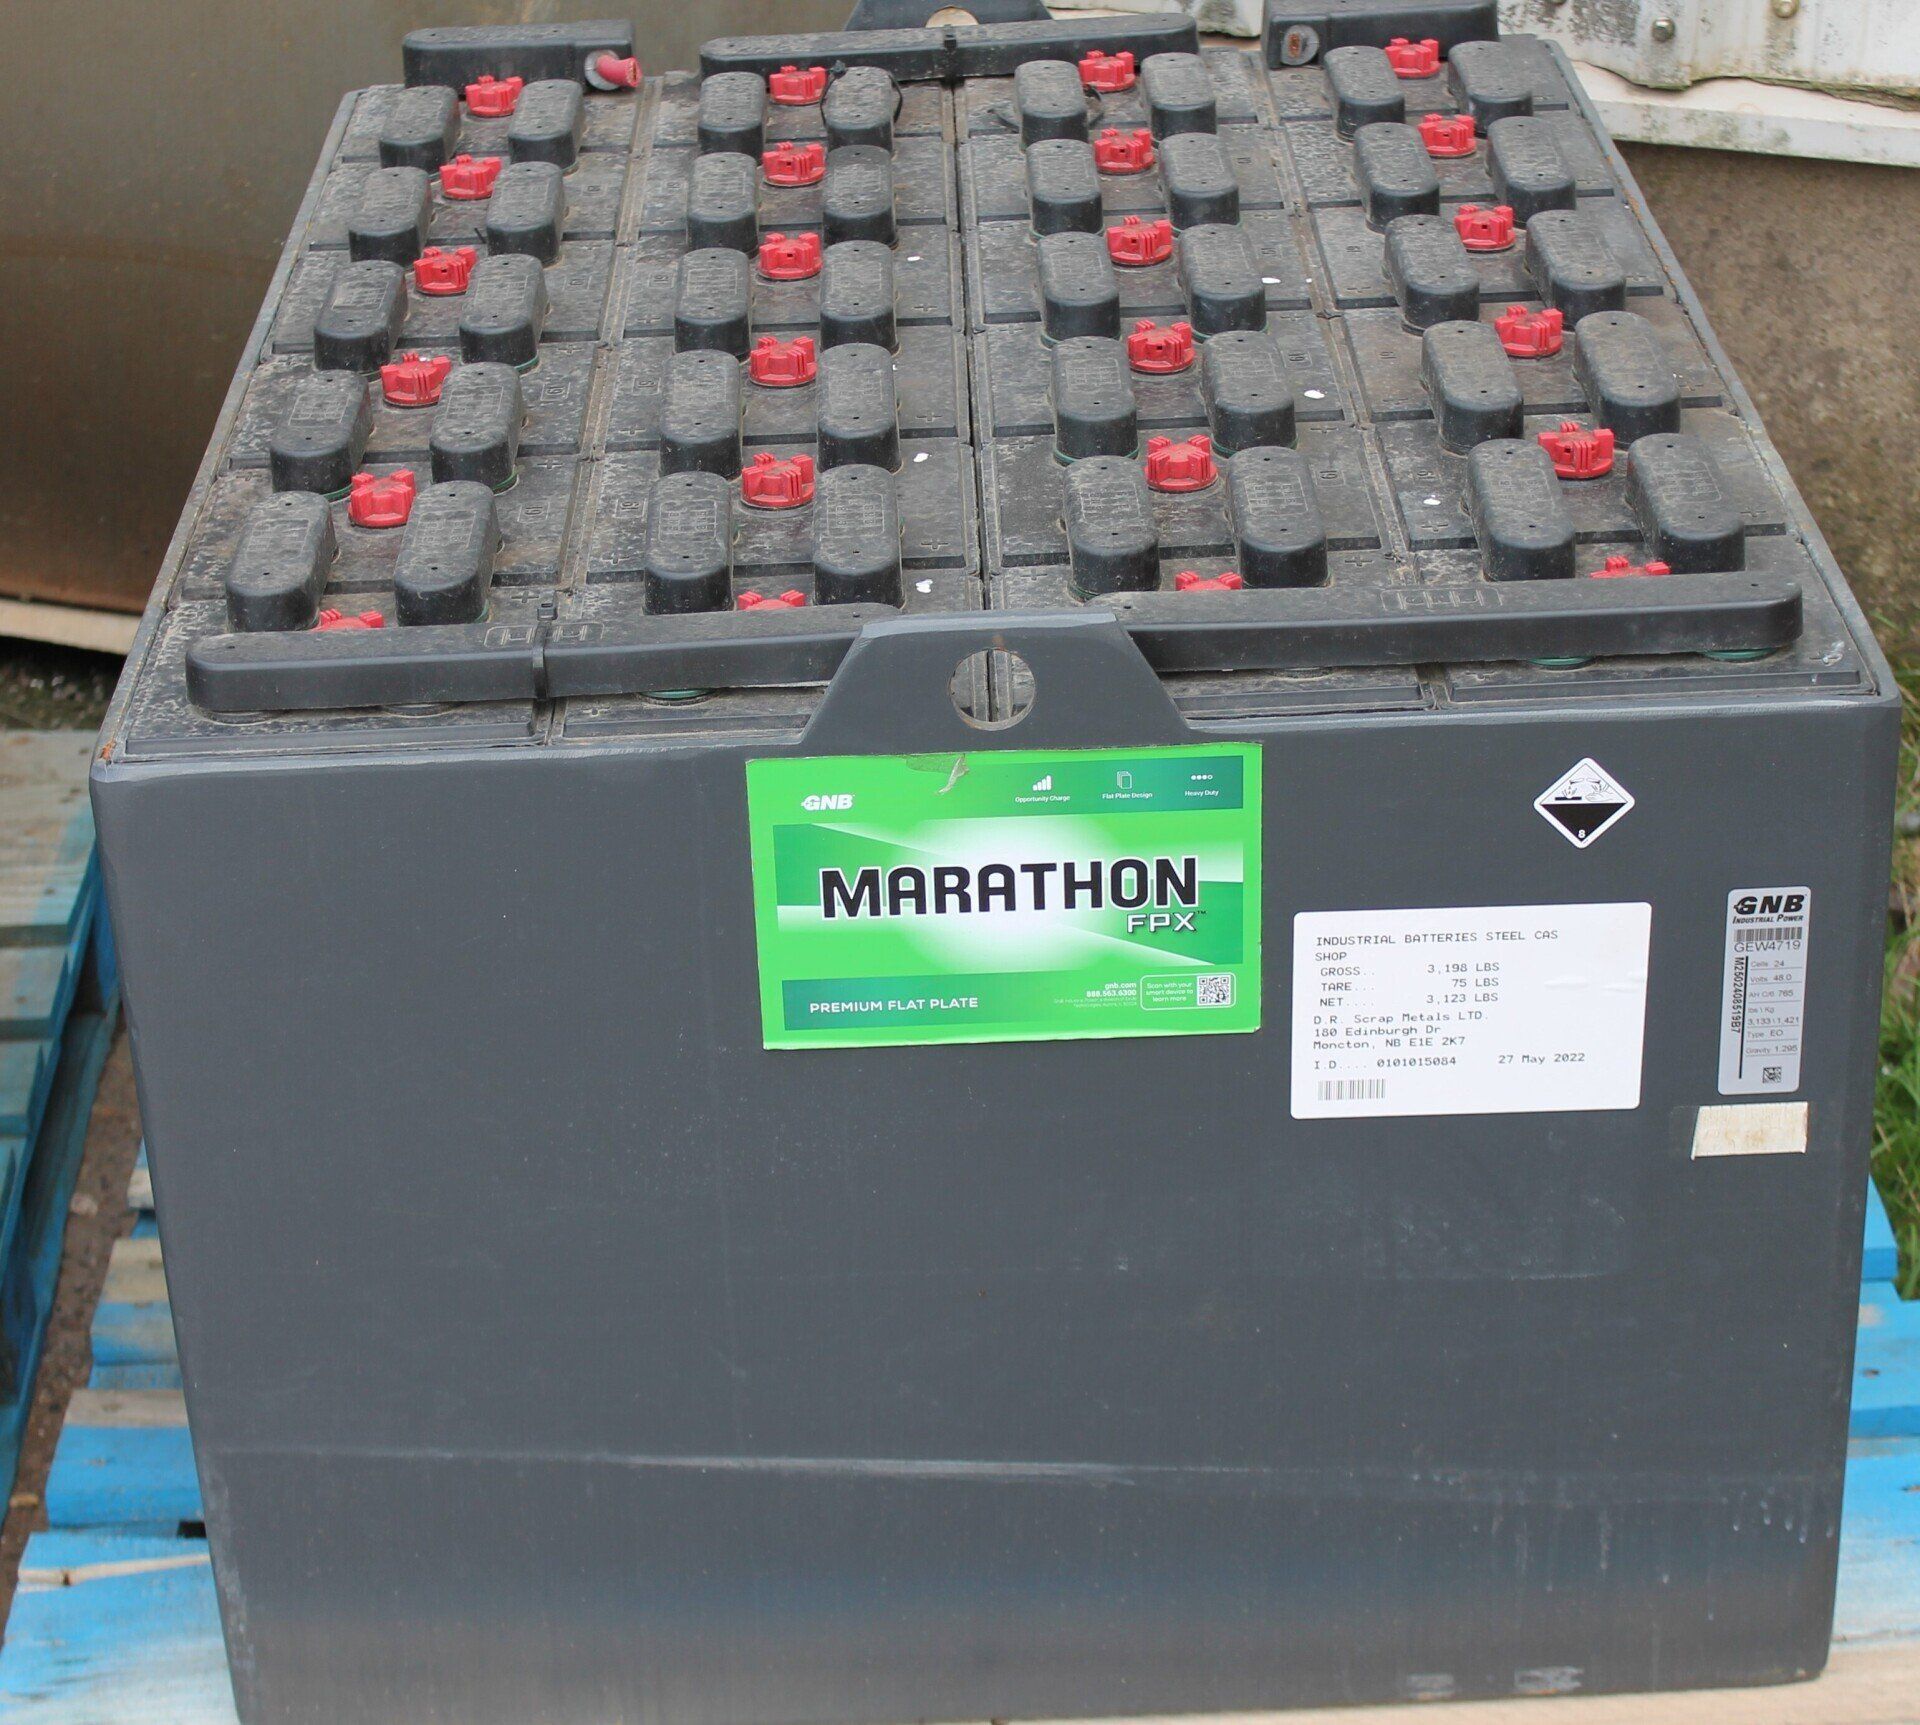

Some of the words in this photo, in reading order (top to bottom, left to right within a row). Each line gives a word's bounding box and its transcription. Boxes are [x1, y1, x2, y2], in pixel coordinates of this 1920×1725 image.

[1132, 791, 1153, 799] Design
[1204, 789, 1219, 797] Duty
[801, 794, 852, 810] GNB
[1578, 830, 1586, 838] 8
[819, 855, 1199, 920] MARATHON
[1734, 895, 1804, 914] GNB
[1316, 935, 1395, 946] INDUSTRIAL
[1405, 932, 1477, 943] BATTERIES
[1486, 930, 1525, 941] STEEL
[1535, 929, 1558, 940] CAS
[1734, 940, 1800, 952] GEW4719
[1315, 951, 1347, 961] SHOP
[1427, 963, 1468, 974] 3,198
[1476, 962, 1500, 972] LBS
[1105, 982, 1136, 990] gnb.com
[1452, 978, 1468, 988] 75
[1475, 977, 1499, 987] LBS
[1427, 992, 1467, 1004] 3,123
[1474, 992, 1498, 1002] LBS
[810, 1001, 883, 1013] PREMIUM
[887, 999, 925, 1011] FLAT
[929, 997, 979, 1009] PLATE
[1314, 1015, 1343, 1025] D.R.
[1354, 1013, 1393, 1024] Scrap
[1403, 1011, 1449, 1022] Metals
[1315, 1027, 1337, 1037] 180
[1346, 1025, 1417, 1036] Edinburgh
[1426, 1025, 1441, 1035] Dr
[1313, 1041, 1376, 1050] Moncton,
[1386, 1038, 1401, 1048] NB
[1410, 1037, 1433, 1047] E1E
[1442, 1036, 1465, 1046] 2K7
[1377, 1057, 1457, 1068] 0101015084
[1498, 1054, 1514, 1064] 27
[1522, 1054, 1545, 1065] May
[1554, 1052, 1585, 1063] 2022
